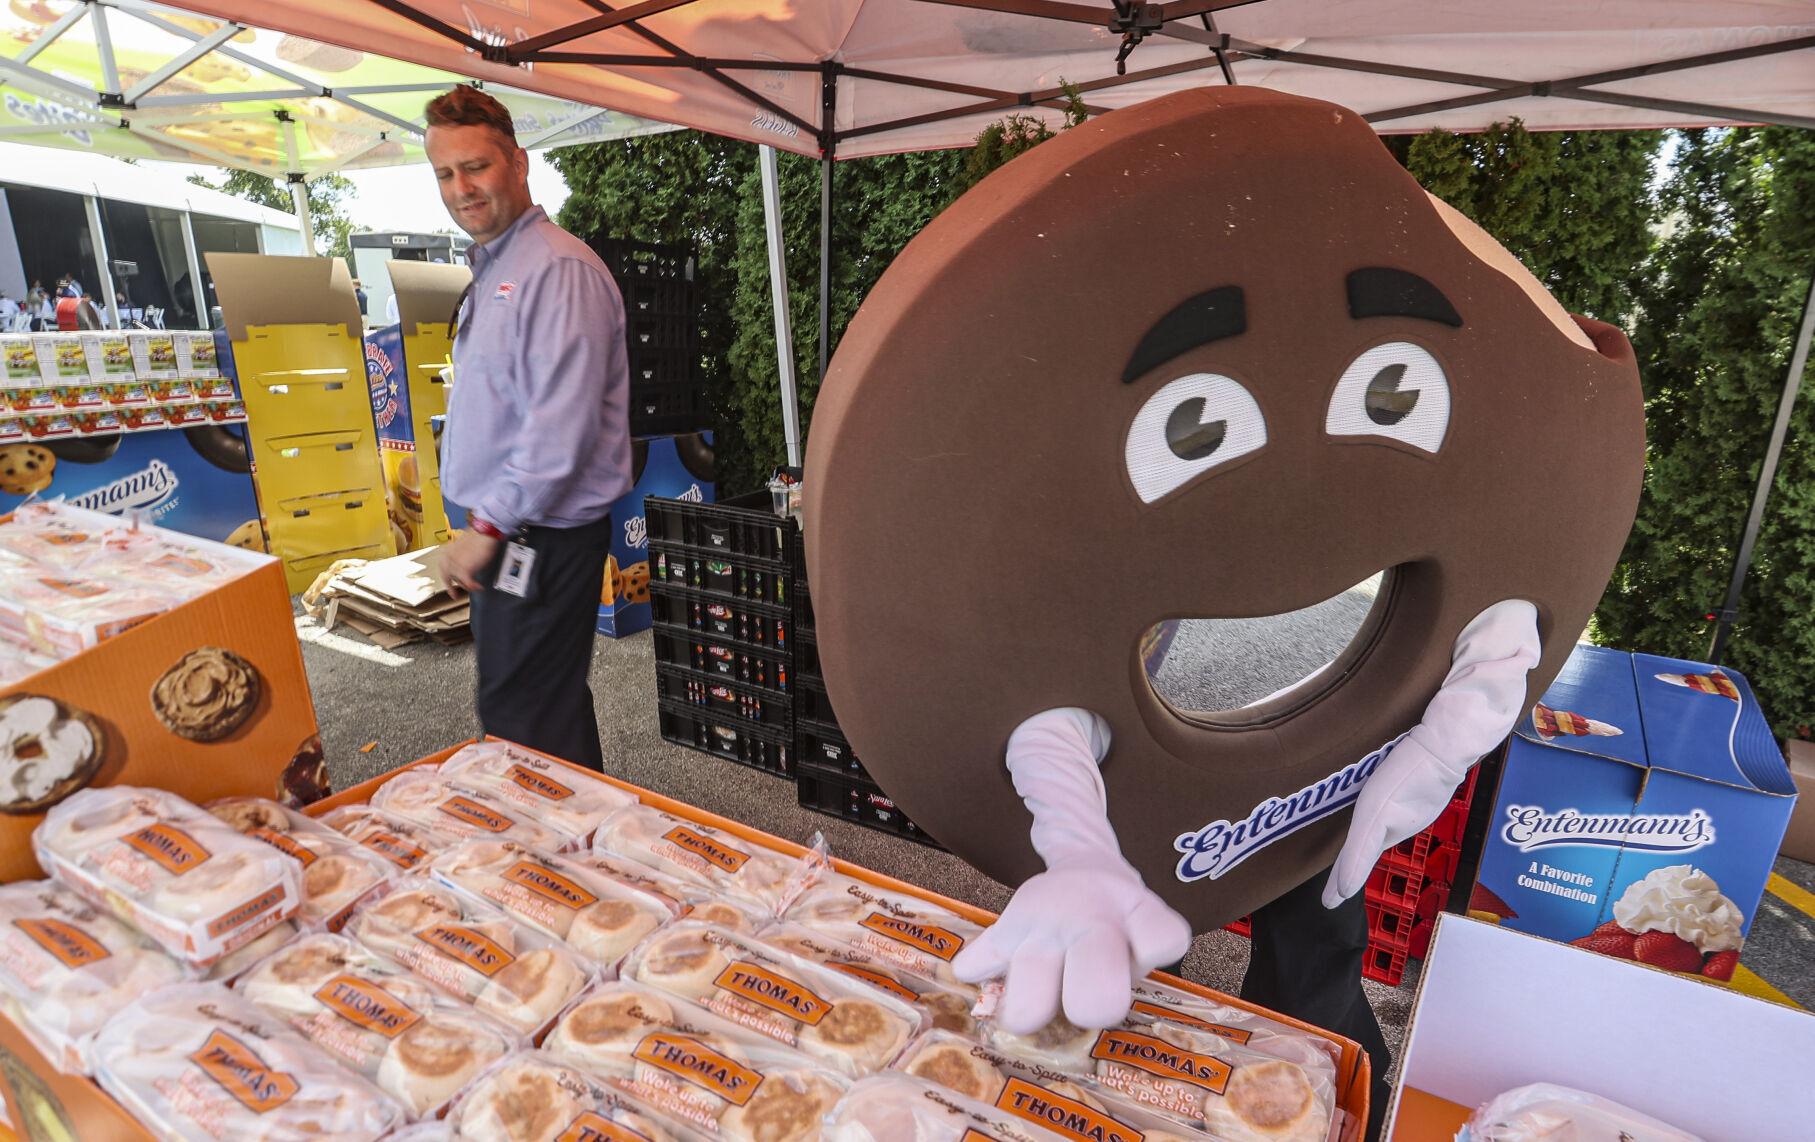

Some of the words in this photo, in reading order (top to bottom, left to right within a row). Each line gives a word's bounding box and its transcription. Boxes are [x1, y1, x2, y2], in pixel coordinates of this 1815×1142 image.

[1180, 744, 1394, 878] Entenma
[1505, 807, 1711, 844] Entenmann's
[1517, 874, 1597, 905] Combination
[1528, 861, 1538, 873] A
[1540, 864, 1594, 888] Favorite
